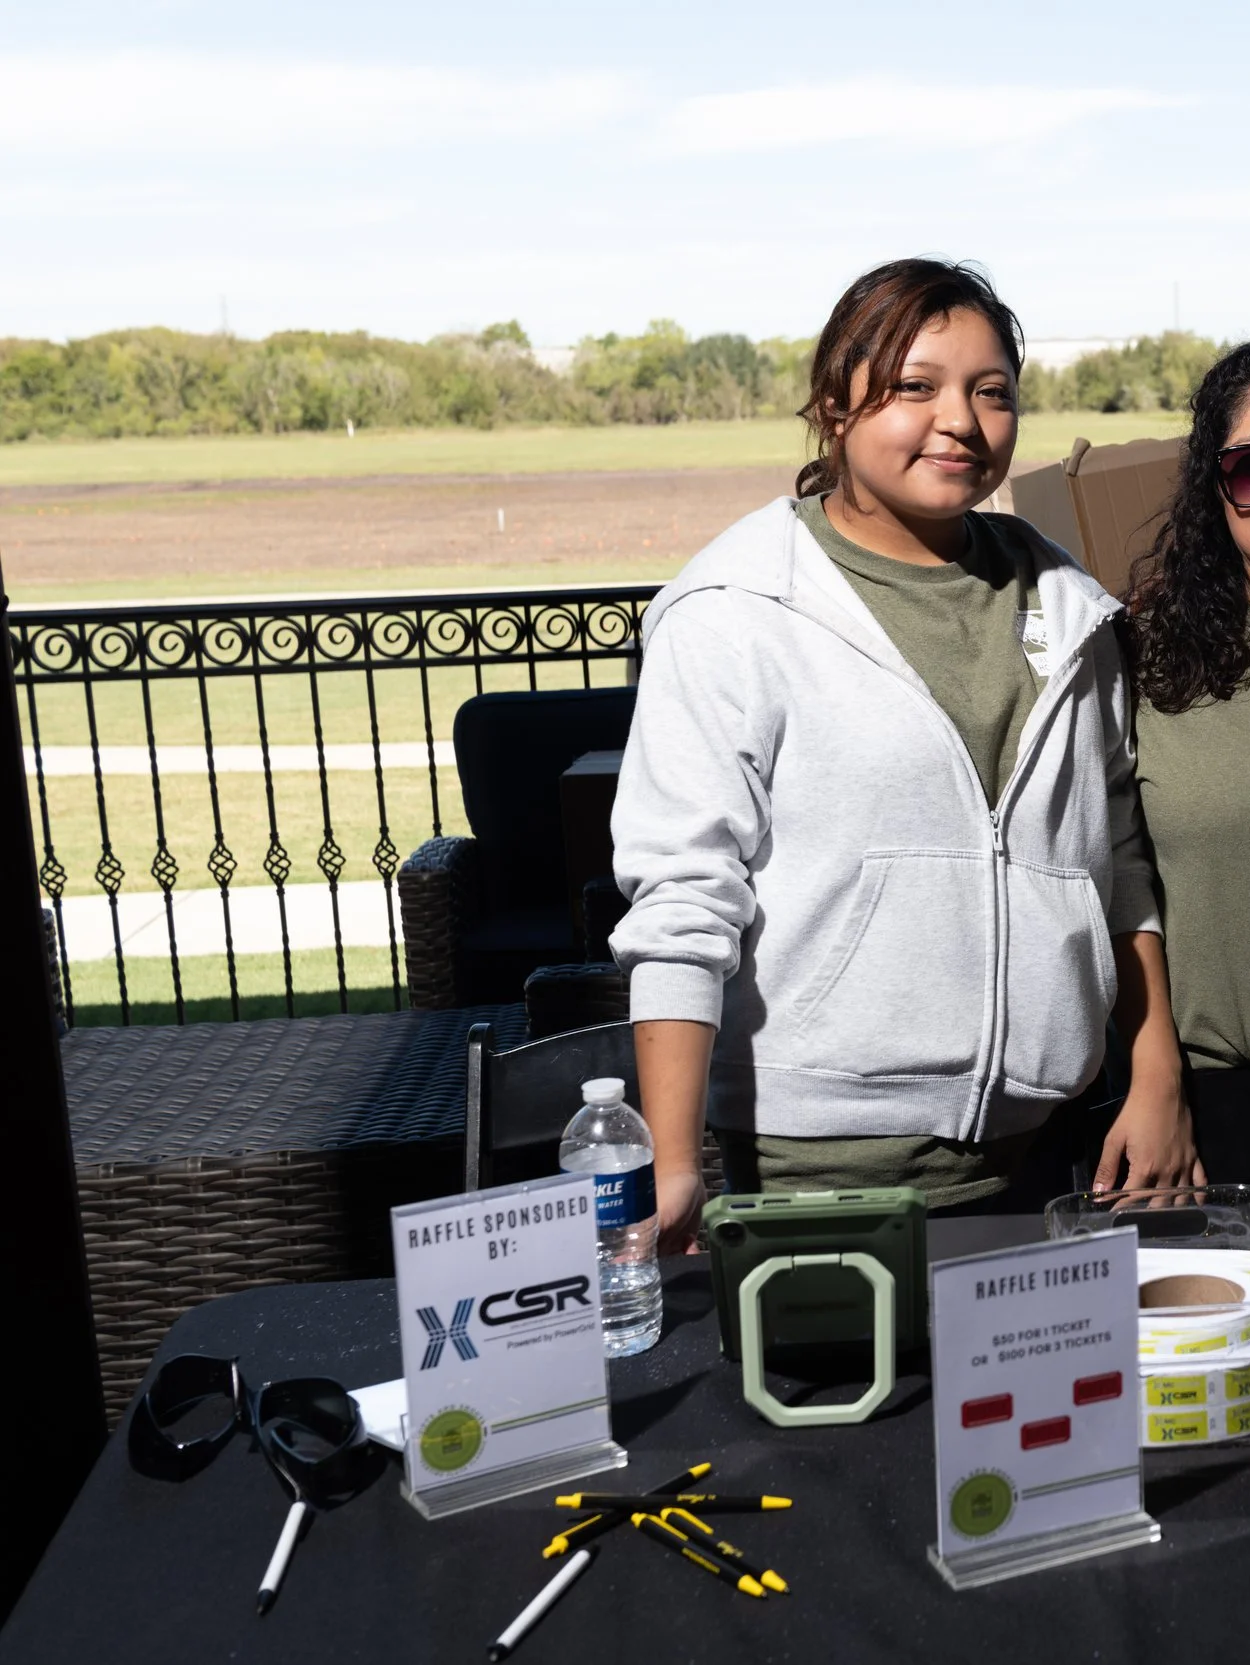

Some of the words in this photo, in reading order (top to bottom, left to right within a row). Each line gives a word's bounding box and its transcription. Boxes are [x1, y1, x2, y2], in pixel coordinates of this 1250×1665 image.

[597, 1199, 624, 1209] WATER
[408, 1217, 475, 1248] RAFFLE
[484, 1196, 588, 1233] SPONSORED
[488, 1238, 517, 1260] BY:
[976, 1272, 1036, 1300] RAFFLE
[1044, 1259, 1110, 1288] TICKETS
[507, 1335, 542, 1350] Powered
[543, 1332, 553, 1342] by
[992, 1333, 1015, 1347] $50
[1018, 1328, 1041, 1342] FOR
[1051, 1318, 1091, 1336] TICKET
[971, 1354, 988, 1367] OR
[998, 1348, 1025, 1363] $100
[1028, 1343, 1051, 1356] FOR
[1054, 1340, 1061, 1352] 3
[1064, 1331, 1112, 1350] TICKETS
